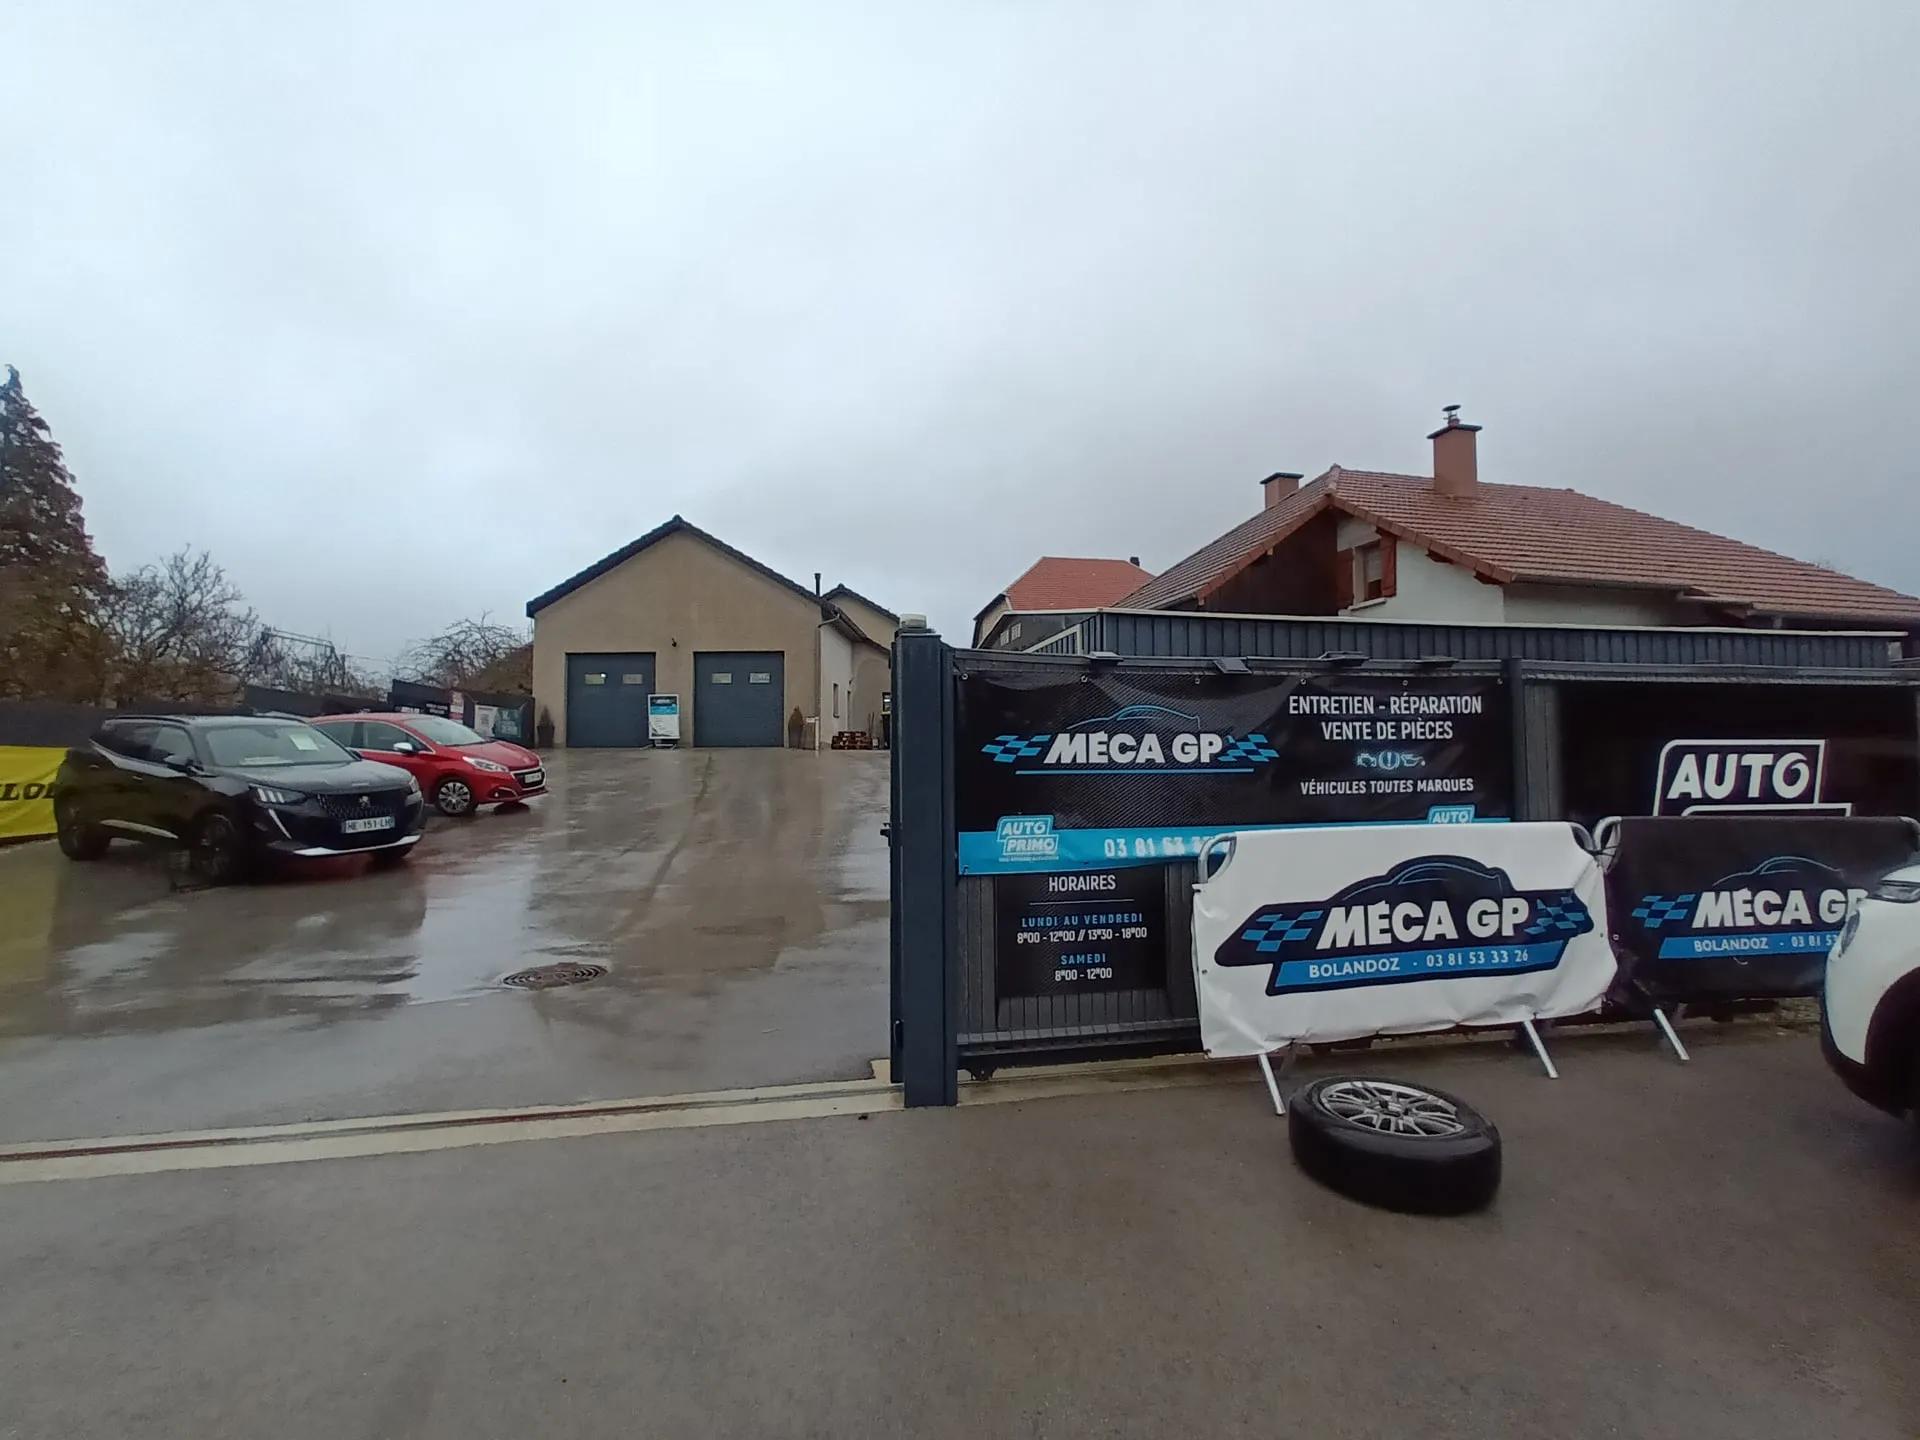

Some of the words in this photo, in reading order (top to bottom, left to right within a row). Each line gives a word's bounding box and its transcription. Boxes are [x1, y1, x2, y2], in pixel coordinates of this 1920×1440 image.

[1289, 695, 1374, 715] ENTRETIEN
[1390, 692, 1482, 715] RÉPARATION
[1321, 721, 1372, 741] VENTE
[1376, 721, 1396, 740] DE
[1401, 717, 1453, 740] PIÈCES
[1043, 731, 1165, 764] MÉCA
[1171, 732, 1223, 764] GP
[1666, 752, 1811, 800] AUTO
[1300, 778, 1367, 796] VÉHICULES
[1370, 779, 1414, 794] TOUTES
[1417, 777, 1474, 793] MARQUES
[1432, 810, 1469, 824] AUTO
[1002, 821, 1046, 836] AUTO
[1007, 838, 1055, 852] PRIMO
[1104, 838, 1128, 858] 03
[1048, 875, 1116, 892] HORAIRES
[1022, 916, 1058, 928] LUNDI
[1064, 915, 1079, 926] AU
[1084, 913, 1143, 925] VENDREDI
[1316, 900, 1459, 950] MÉCA
[1466, 897, 1529, 938] GP
[1693, 936, 1769, 953] BOLANDOZ
[1061, 953, 1106, 965] SAMEDI
[1308, 957, 1401, 979] BOLANDOZ
[1426, 954, 1443, 968] 03
[1448, 953, 1463, 966] 81
[1469, 951, 1485, 965] 53
[1490, 950, 1509, 964] 33
[1515, 949, 1529, 963] 26
